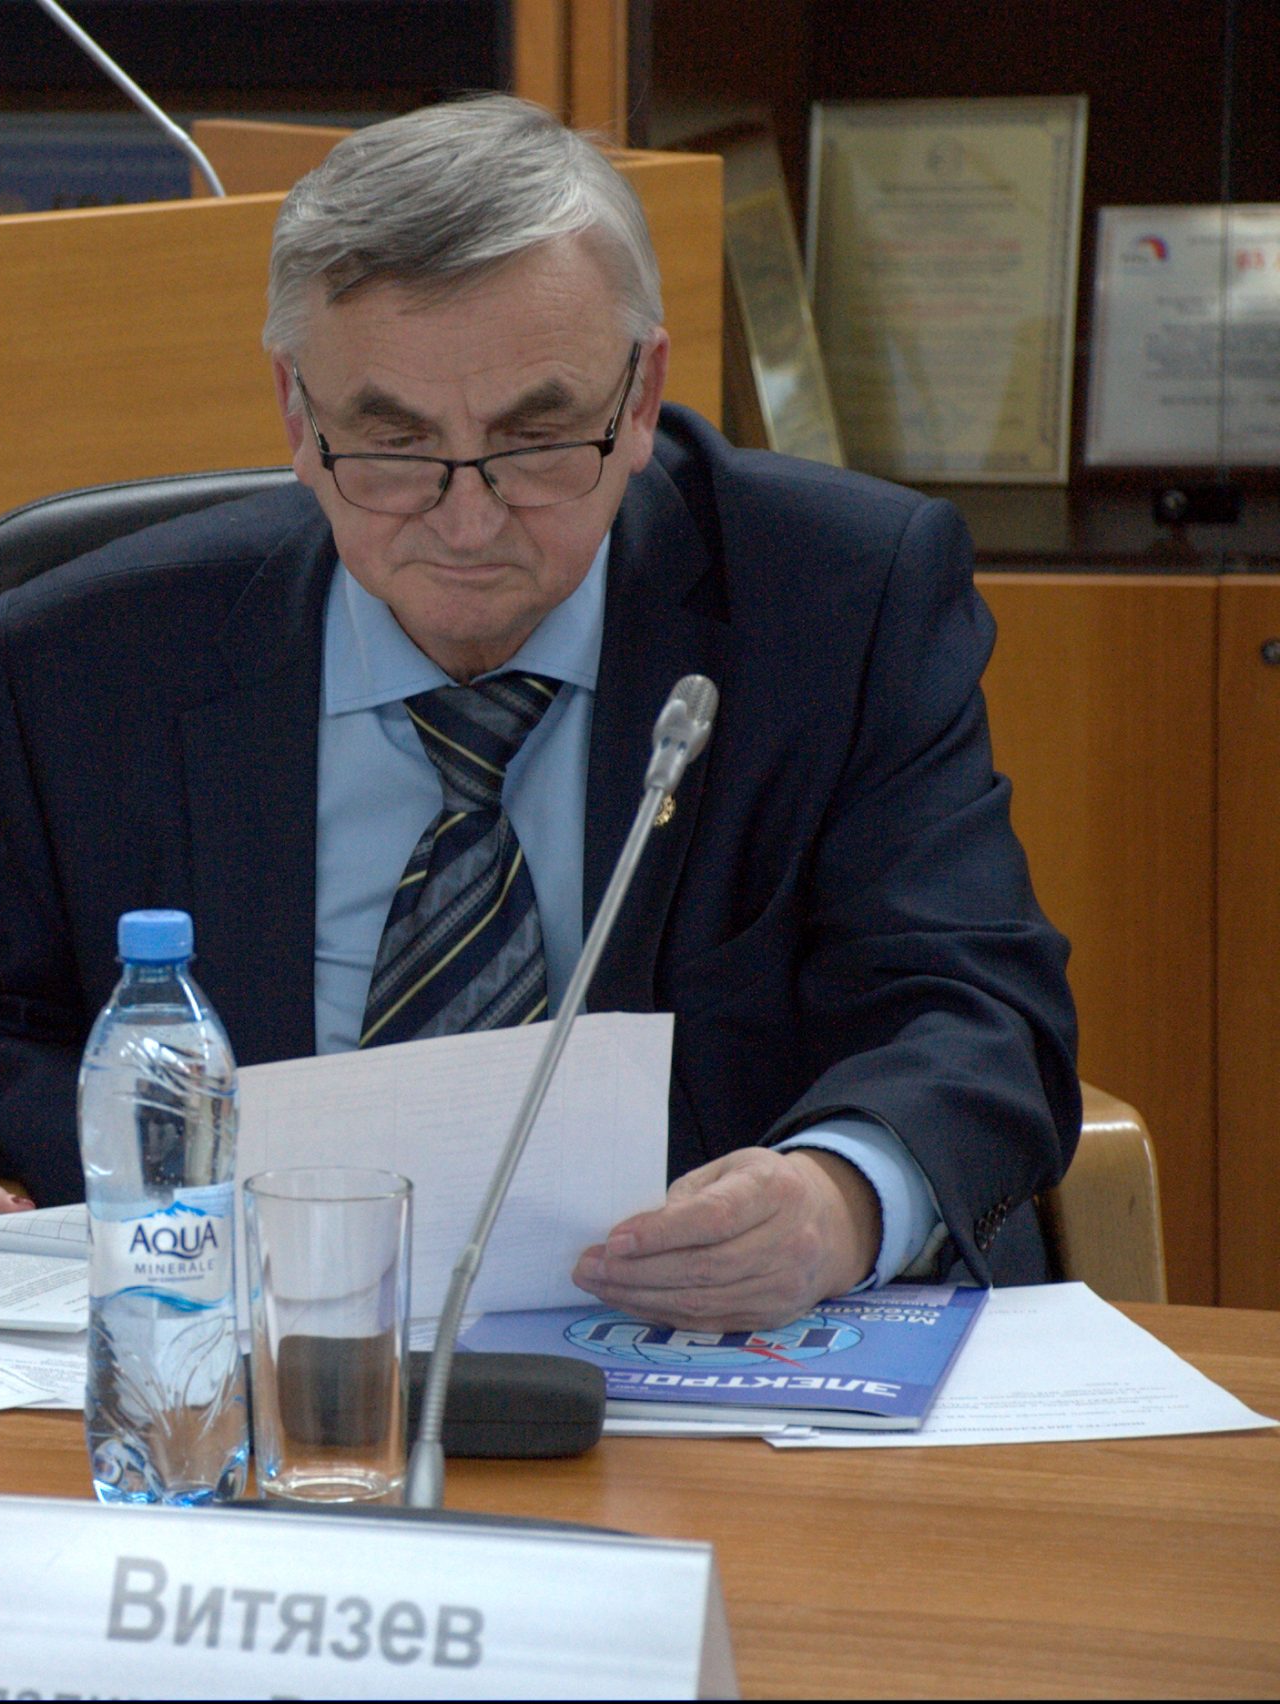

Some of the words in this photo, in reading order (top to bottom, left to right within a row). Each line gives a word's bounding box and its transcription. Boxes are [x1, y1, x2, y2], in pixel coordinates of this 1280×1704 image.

[129, 1220, 218, 1259] AQUA
[134, 1258, 214, 1275] MINERALE
[604, 1370, 902, 1398] ЭЛЕКТРОС
[106, 1555, 485, 1670] Витязев
